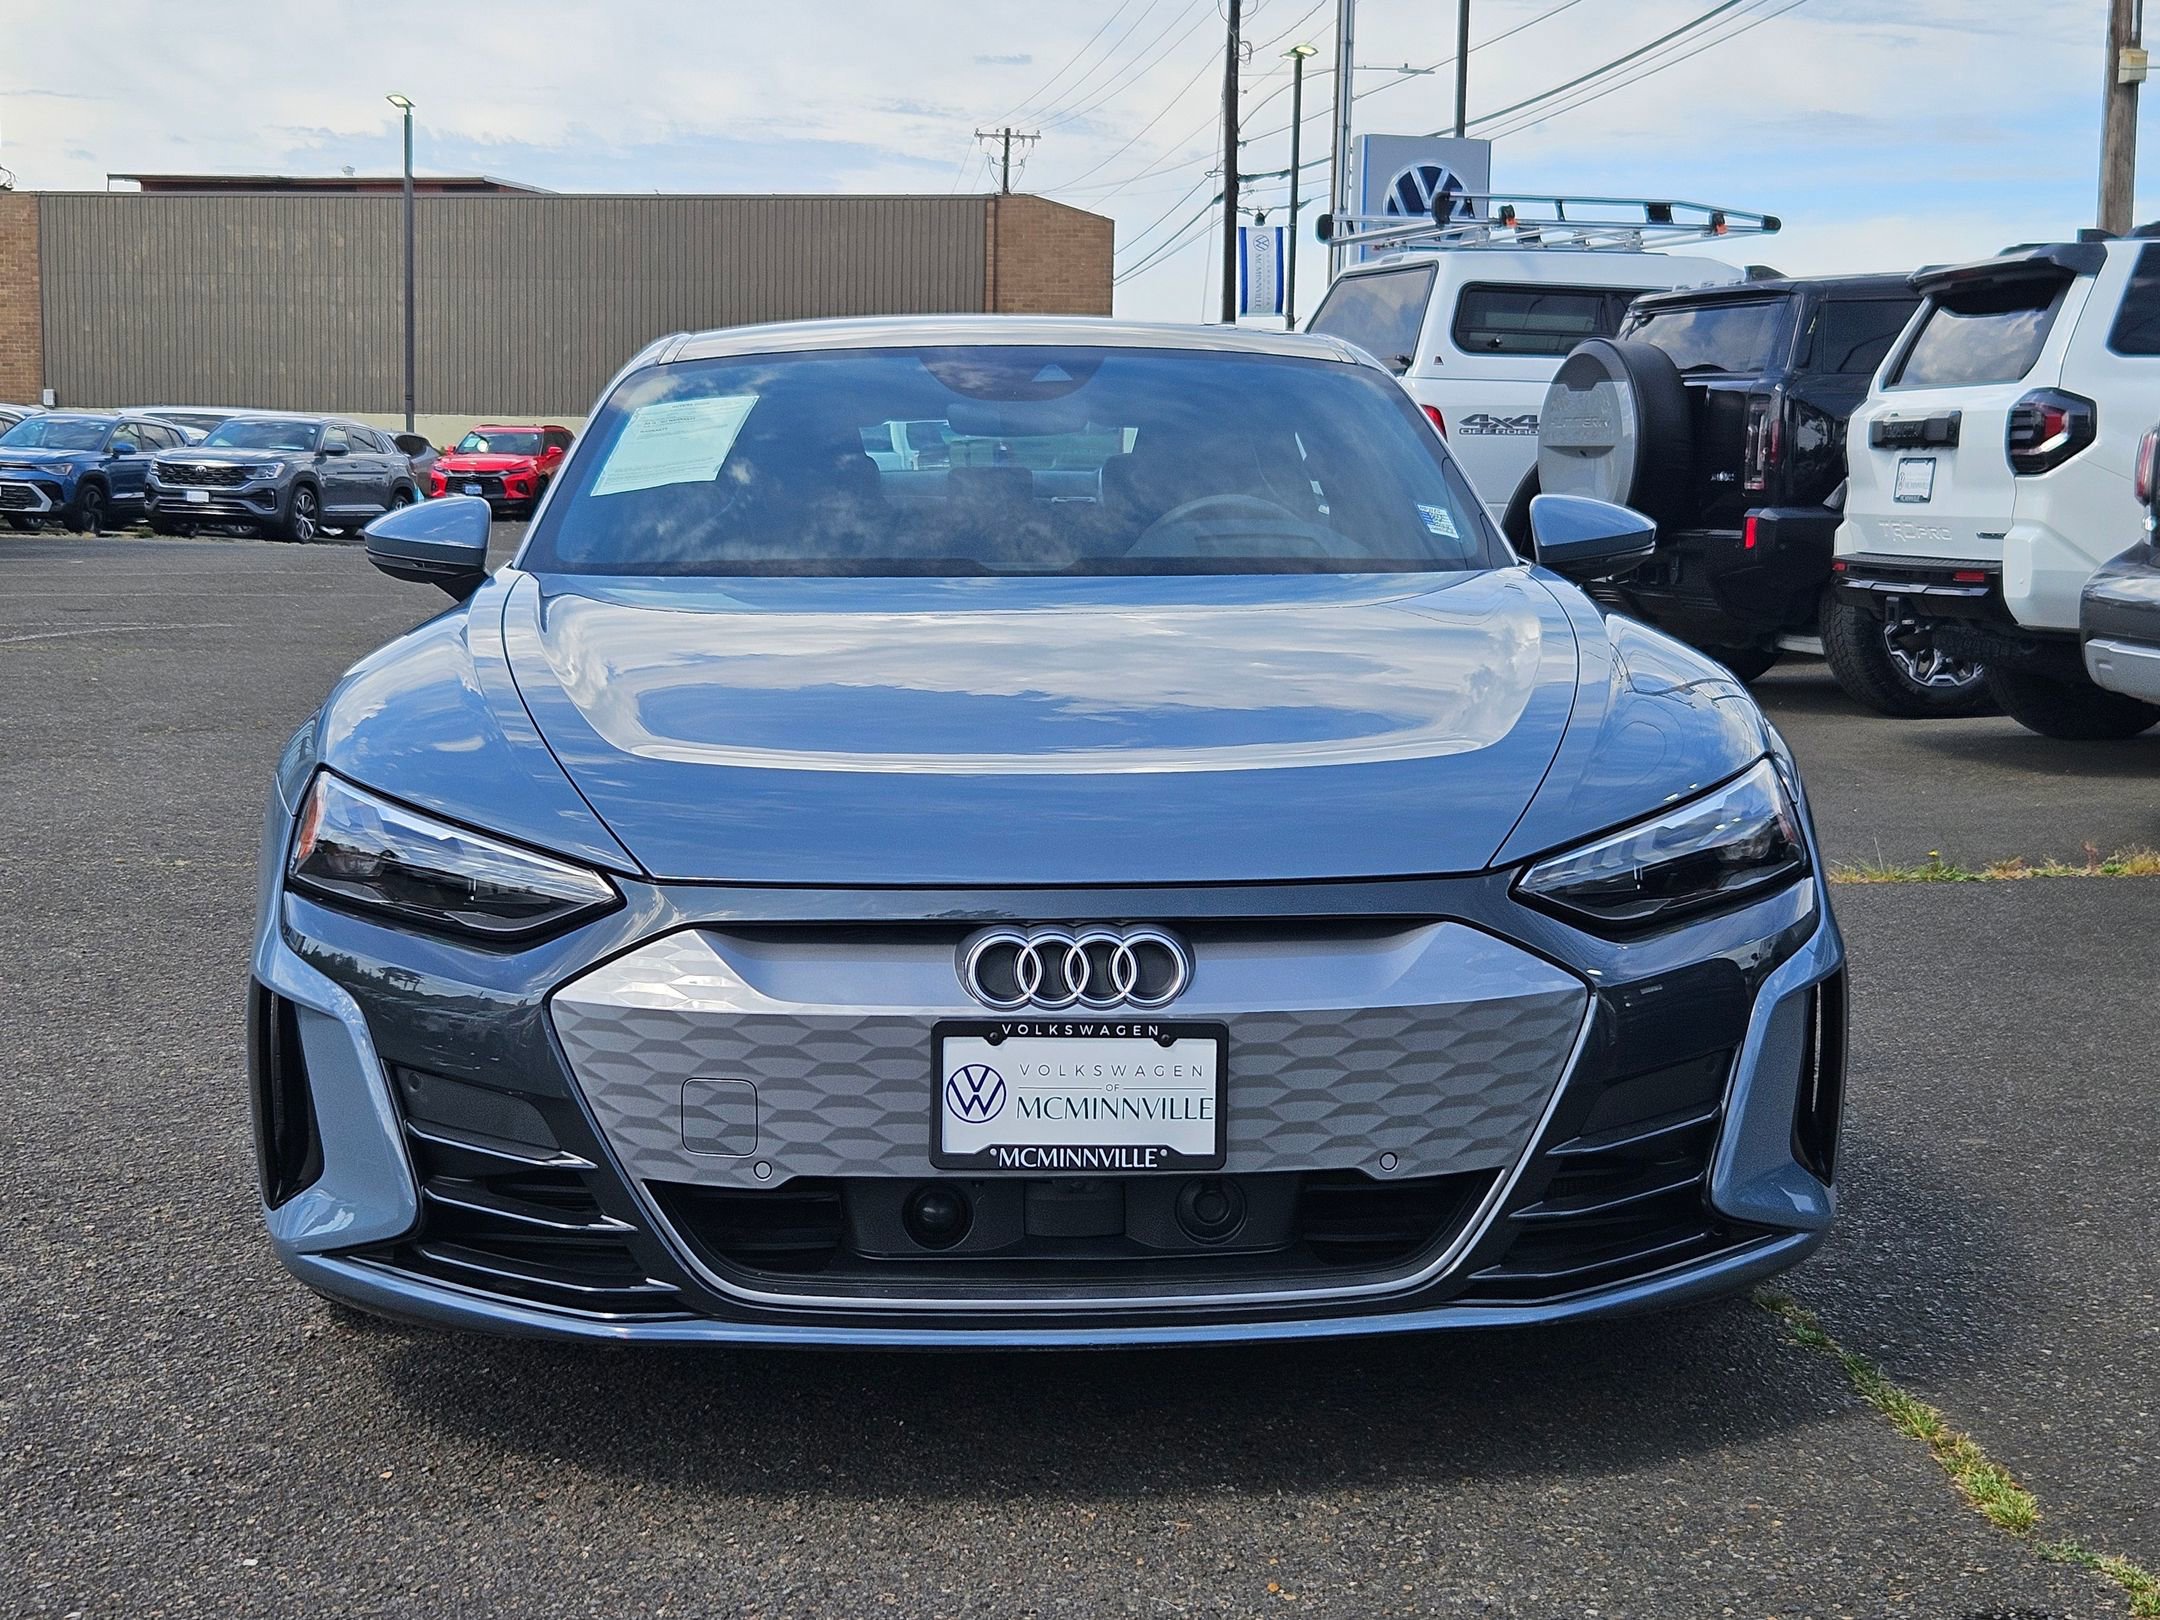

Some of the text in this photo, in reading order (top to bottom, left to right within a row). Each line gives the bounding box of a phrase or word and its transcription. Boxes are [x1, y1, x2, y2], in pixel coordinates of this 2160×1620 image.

[1917, 526, 1953, 541] PRO
[1001, 1023, 1159, 1037] VOLKSWAGEN
[1019, 1064, 1204, 1078] VOLKSWAGEN
[1105, 1083, 1120, 1092] OF
[1016, 1096, 1214, 1120] MCMINNVILLE
[999, 1147, 1158, 1168] MCMINNVILLE
